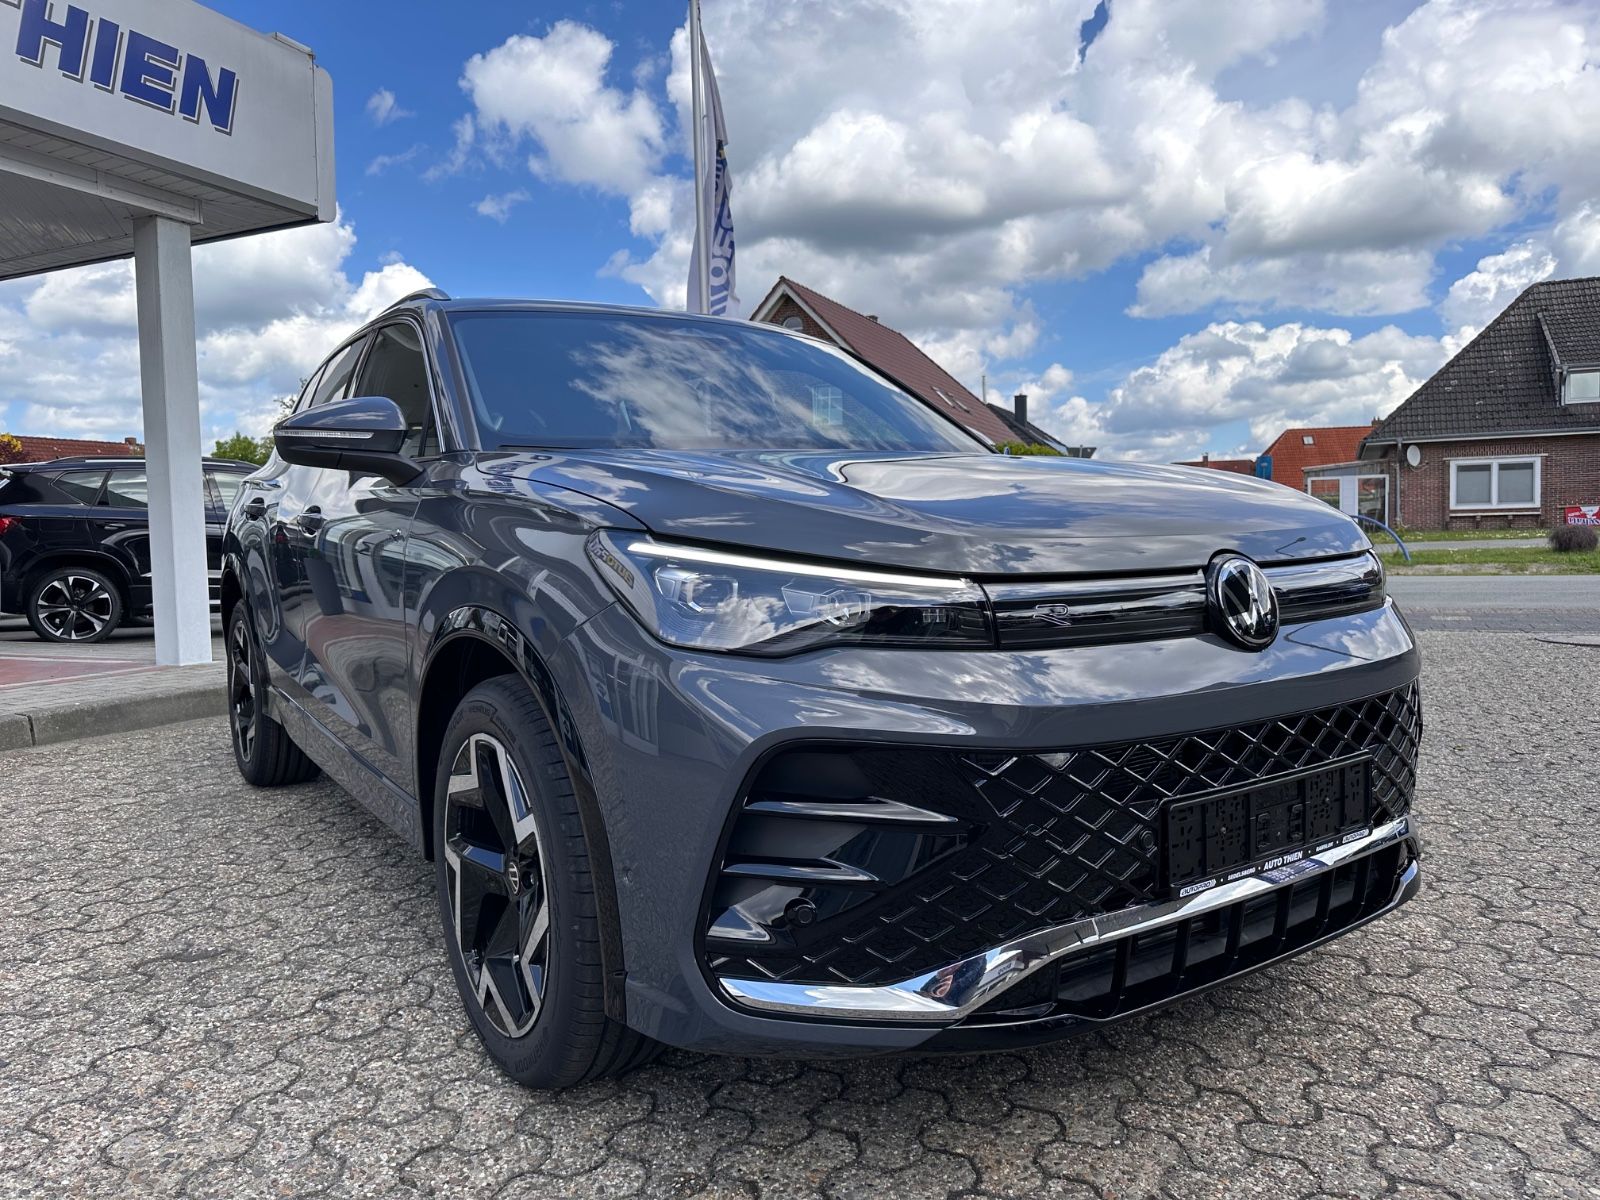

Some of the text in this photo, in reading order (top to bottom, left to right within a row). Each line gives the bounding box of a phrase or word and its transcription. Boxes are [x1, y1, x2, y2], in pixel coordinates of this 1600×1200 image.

[0, 0, 239, 136] HIEN
[1263, 858, 1283, 871] AUTO
[1283, 850, 1303, 865] THIEN
